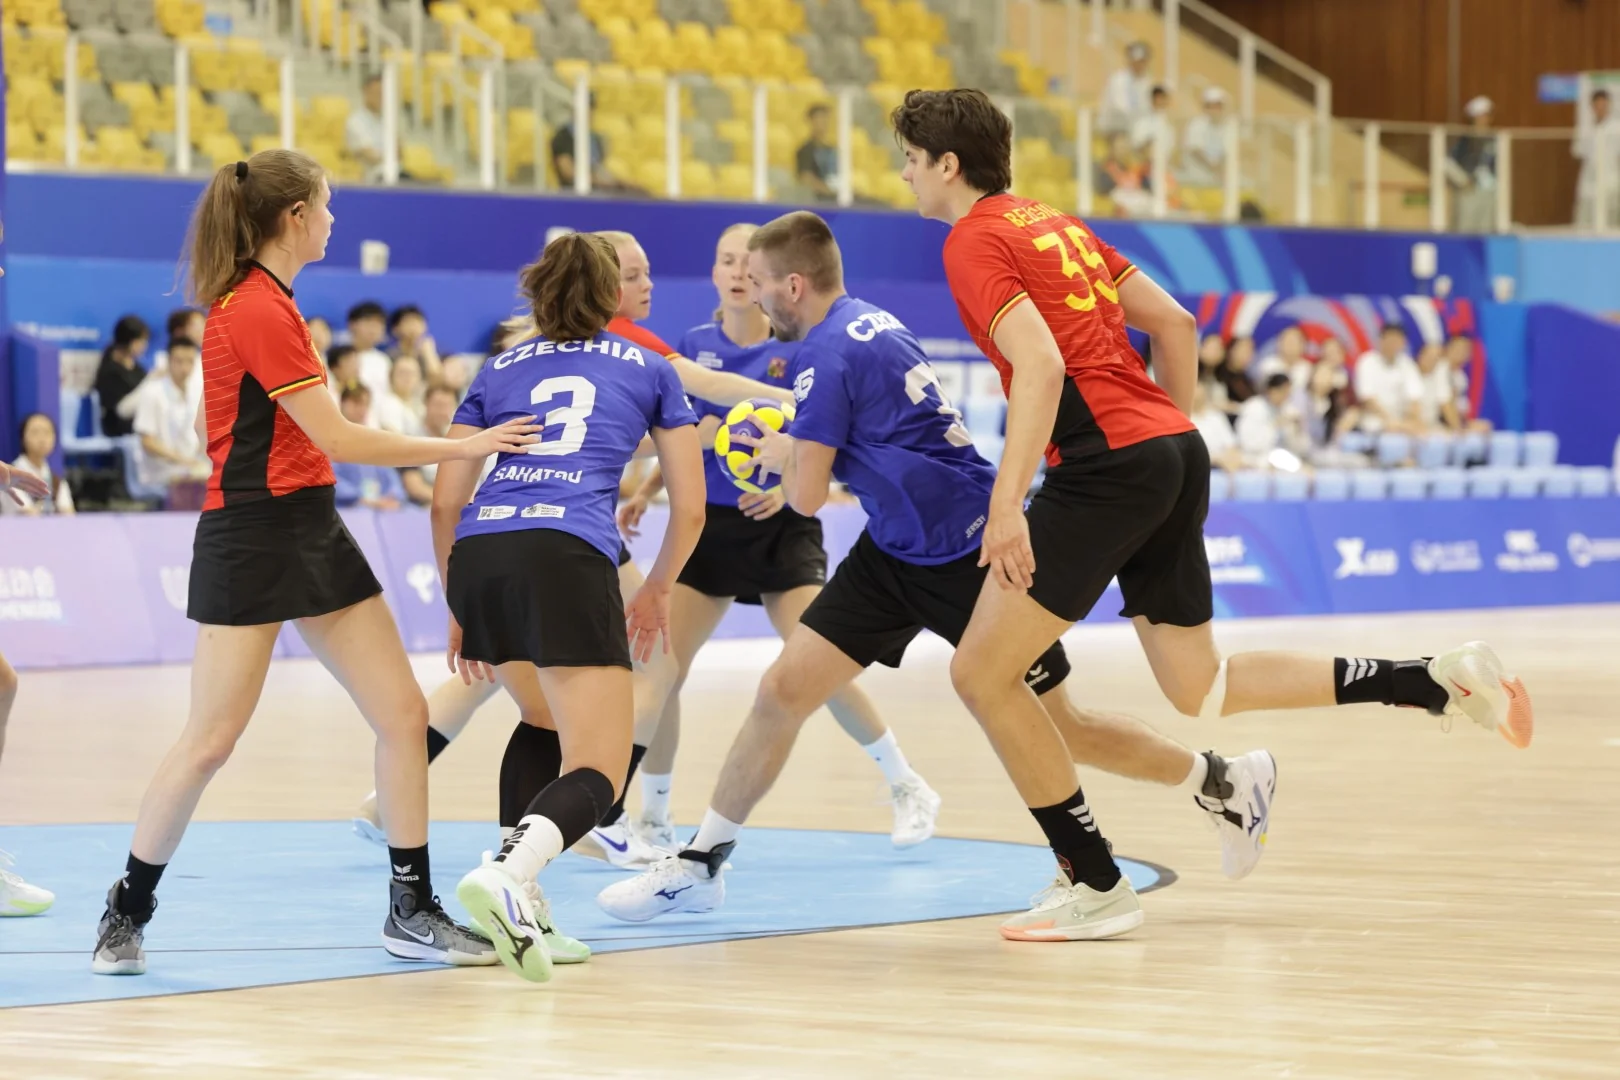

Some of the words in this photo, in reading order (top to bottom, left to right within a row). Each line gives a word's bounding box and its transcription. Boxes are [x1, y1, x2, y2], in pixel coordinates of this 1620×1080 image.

[1032, 225, 1119, 311] 35
[493, 340, 645, 370] CZECHIA
[527, 375, 597, 456] 3
